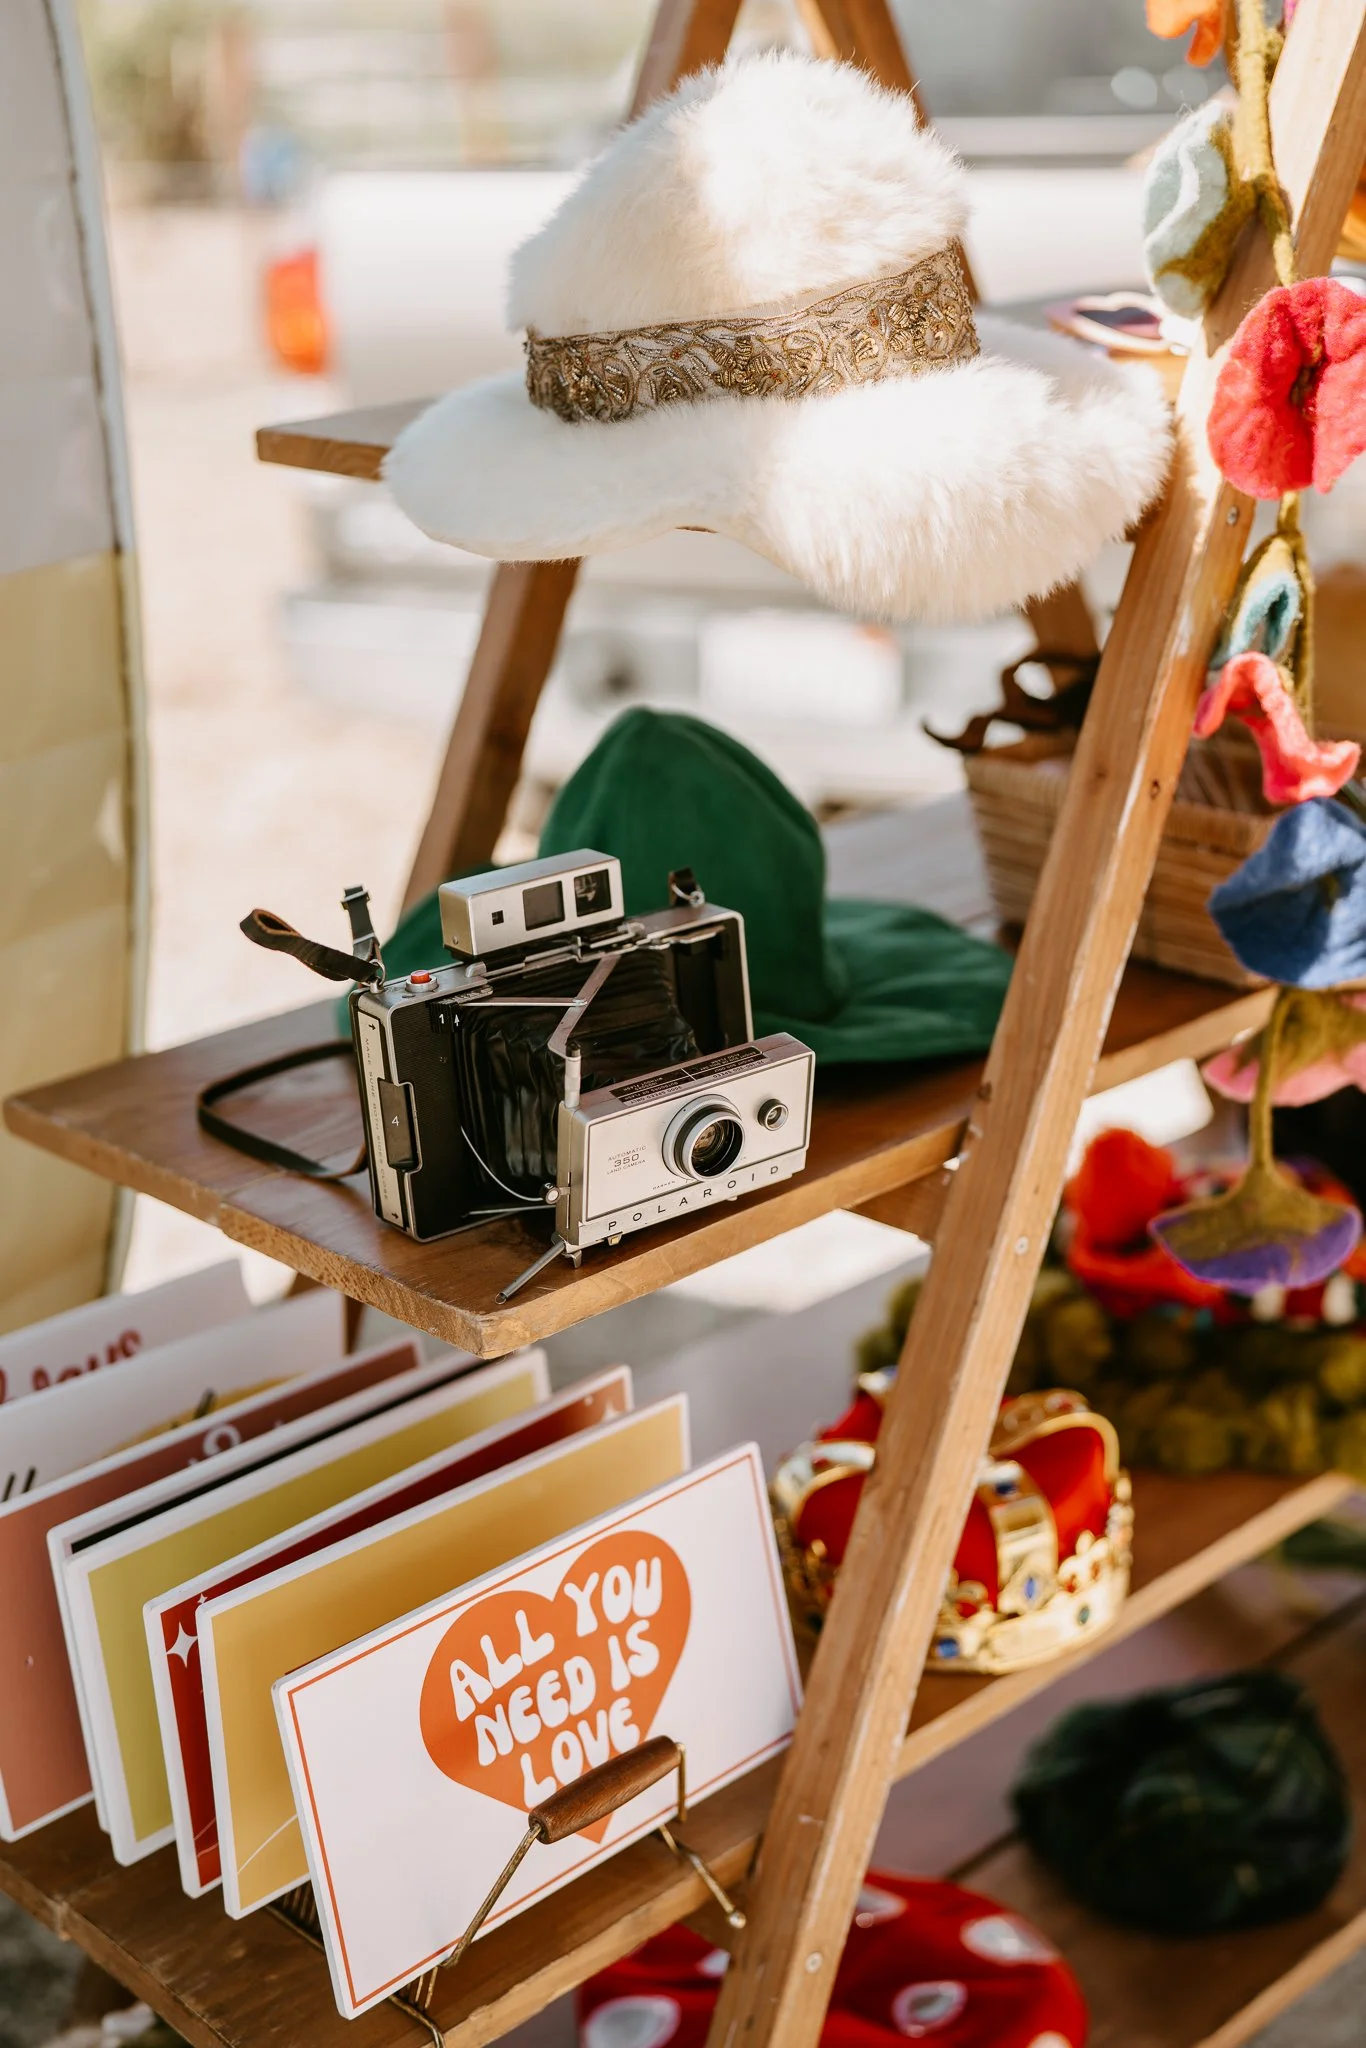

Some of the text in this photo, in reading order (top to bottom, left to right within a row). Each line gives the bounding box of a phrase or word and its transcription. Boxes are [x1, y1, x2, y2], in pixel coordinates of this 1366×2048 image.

[438, 1013, 445, 1025] 1
[391, 1115, 400, 1127] 4
[608, 1145, 647, 1161] AUTOMATIC
[614, 1153, 640, 1168] 350
[623, 1159, 646, 1170] CAMERA
[608, 1166, 779, 1231] POLAROID
[449, 1556, 663, 1722] ALL YOU
[474, 1619, 660, 1767] NEED IS
[520, 1697, 640, 1809] LOVE
